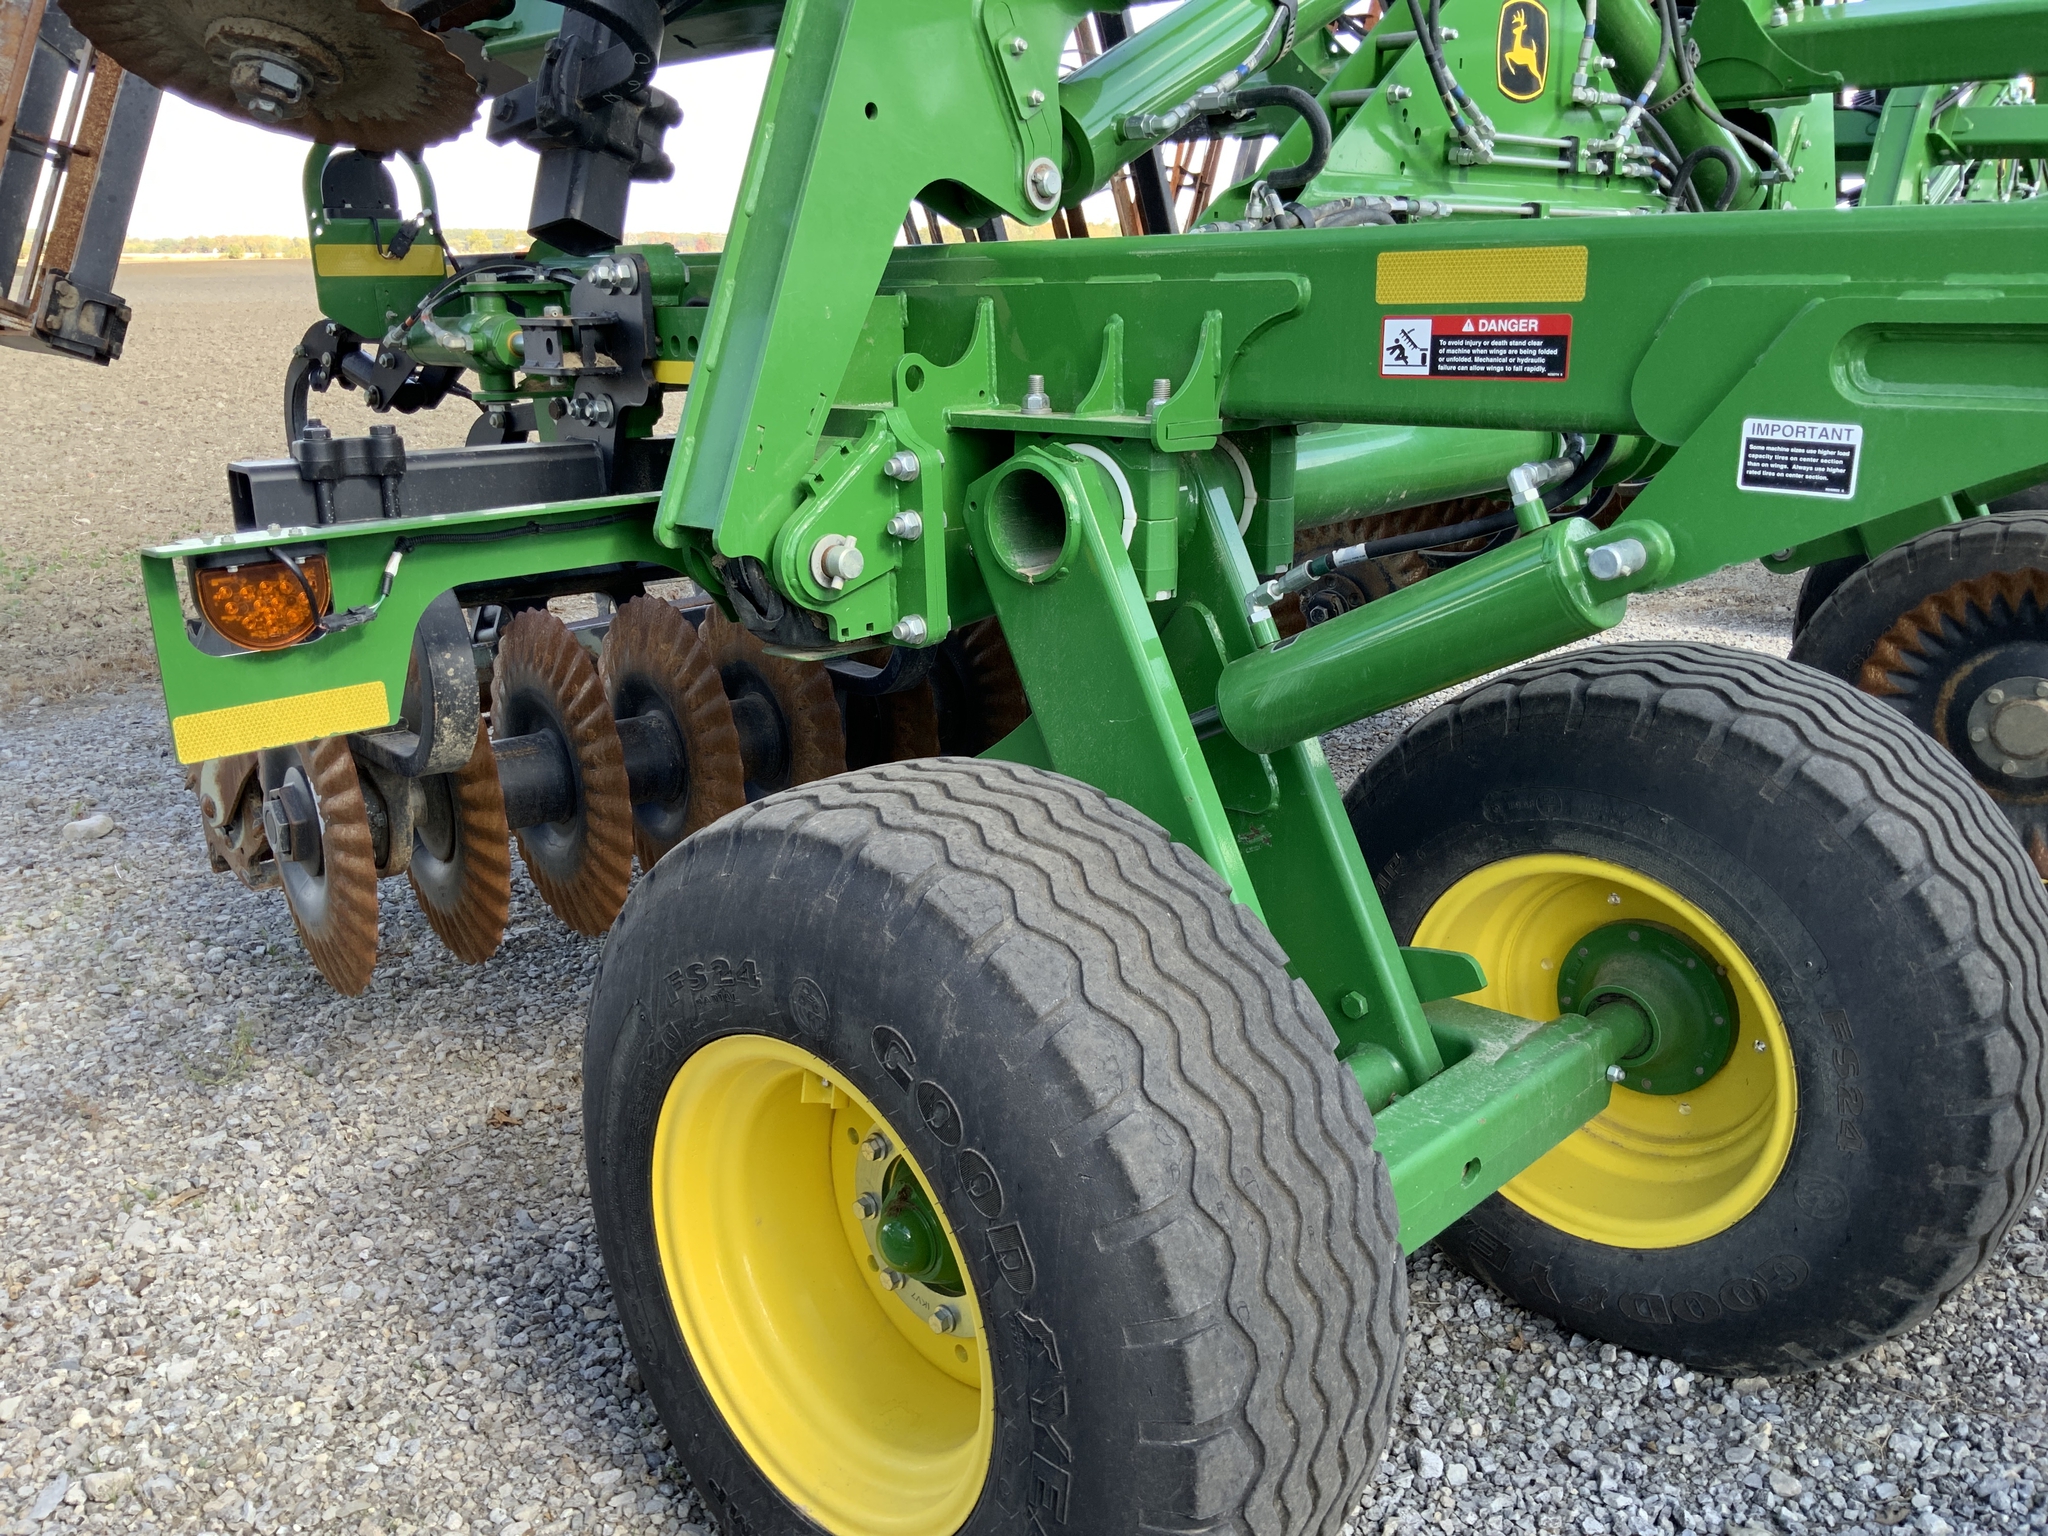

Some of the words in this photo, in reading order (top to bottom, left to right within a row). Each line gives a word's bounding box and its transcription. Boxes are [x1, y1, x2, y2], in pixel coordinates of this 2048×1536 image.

[1479, 319, 1538, 332] DANGER
[1751, 423, 1854, 441] IMPORTANT
[663, 957, 763, 1005] FS24
[1818, 1008, 1866, 1152] FS24
[870, 1024, 1072, 1536] GOODYE
[1468, 1225, 1811, 1326] GOODYE
